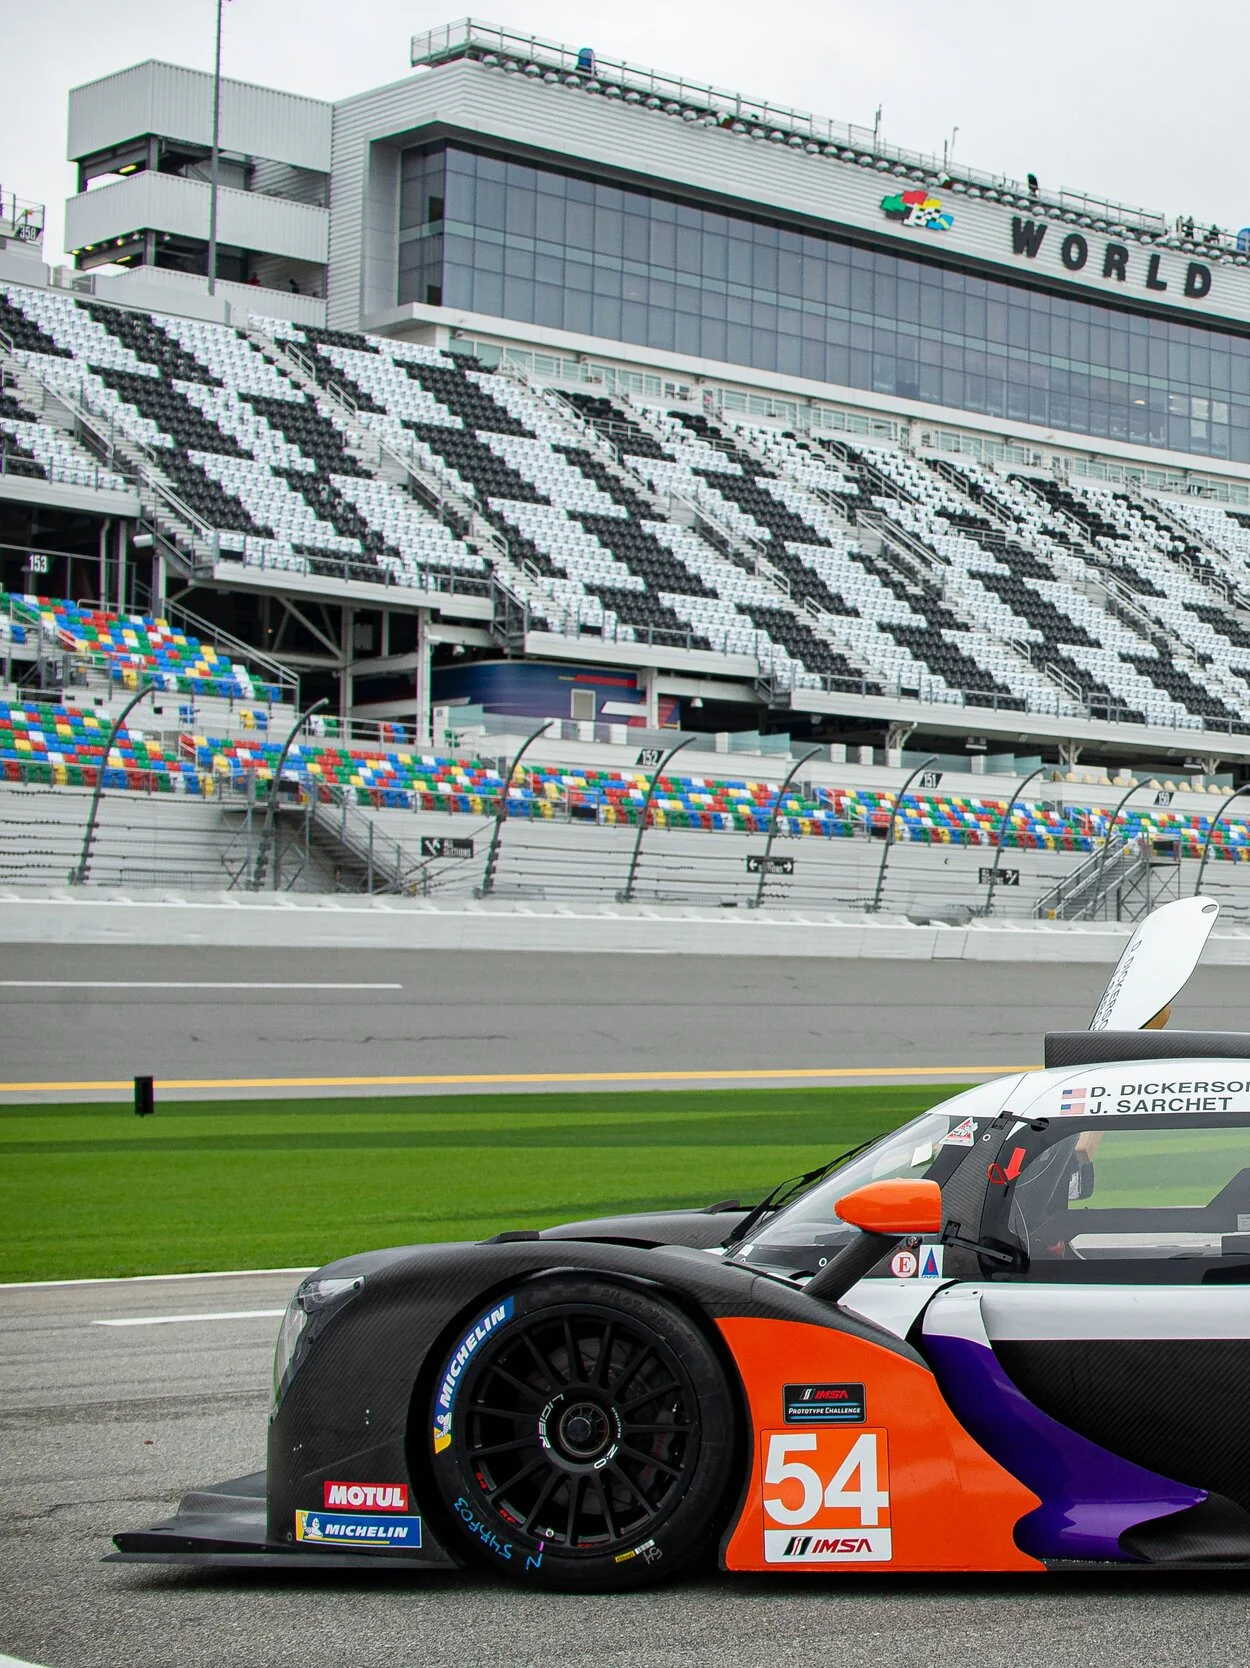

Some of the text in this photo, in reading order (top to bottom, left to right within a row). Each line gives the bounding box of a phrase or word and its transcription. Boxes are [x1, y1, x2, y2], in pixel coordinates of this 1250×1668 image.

[1011, 215, 1213, 299] WORLD
[29, 555, 47, 573] 153
[642, 750, 658, 766] 152
[924, 773, 937, 788] 151
[1090, 1086, 1111, 1098] D.
[1089, 1096, 1233, 1115] J. SARCHET
[898, 1256, 911, 1273] E
[439, 1304, 506, 1408] MICHELIN
[814, 1390, 849, 1400] IMSA
[788, 1407, 824, 1415] PROTOTYPE
[611, 1406, 622, 1438] RACING
[763, 1433, 889, 1526] 54
[328, 1485, 405, 1508] MOTUL
[324, 1523, 409, 1539] MICHELIN
[811, 1538, 873, 1553] IMSA
